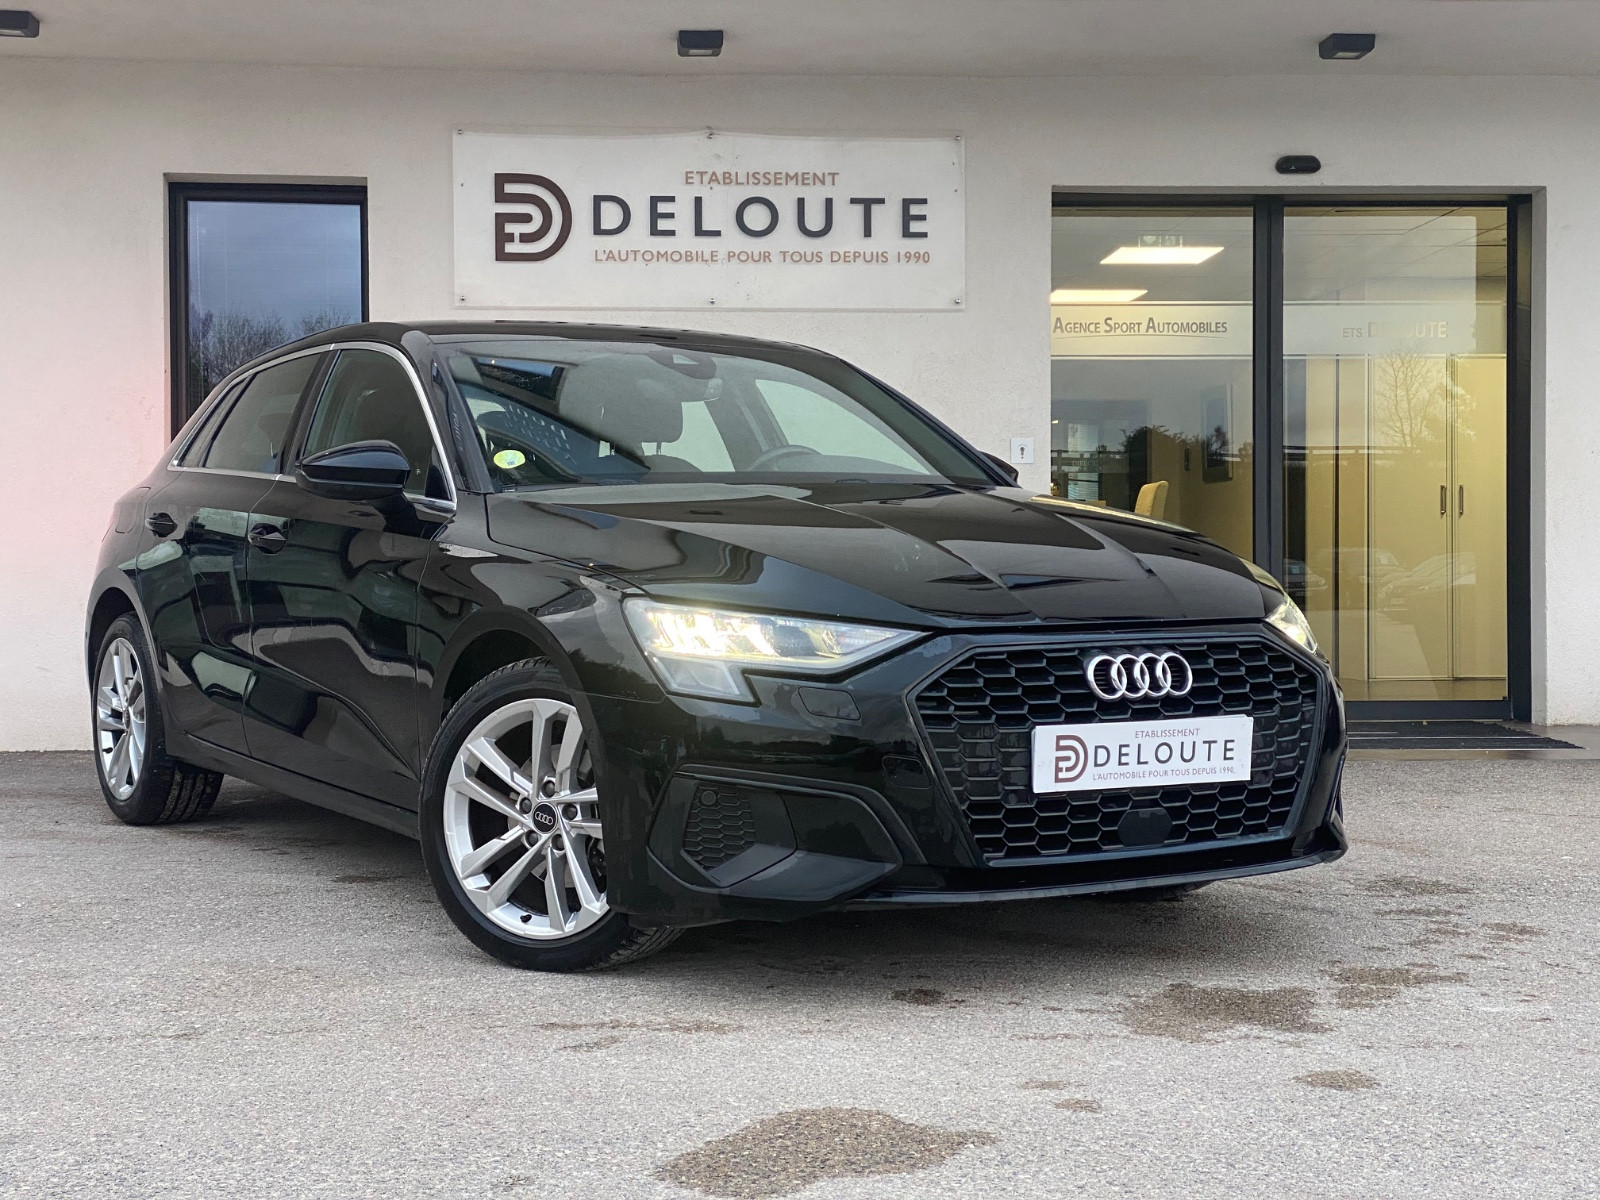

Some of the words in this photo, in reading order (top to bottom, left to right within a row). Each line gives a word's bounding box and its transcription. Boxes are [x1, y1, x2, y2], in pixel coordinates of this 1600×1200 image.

[685, 170, 840, 186] ETABLISSEMENT
[592, 194, 929, 238] DELOUTE
[594, 249, 719, 263] L'AUTOMOBILE
[728, 251, 772, 263] POUR
[780, 251, 823, 263] TOUS
[830, 251, 889, 263] DEPUIS
[896, 251, 931, 263] 1990
[1342, 327, 1363, 338] ETS
[1367, 321, 1448, 338] DUTE
[1135, 728, 1200, 738] ETABLISSEMENT
[1093, 739, 1235, 767] DELOUTE
[1092, 769, 1146, 781] L'AUTOMOBILE
[1148, 769, 1169, 778] POUR
[1171, 768, 1190, 777] TOUS
[1192, 767, 1217, 775] DEPUIS
[1219, 766, 1234, 774] 1990
